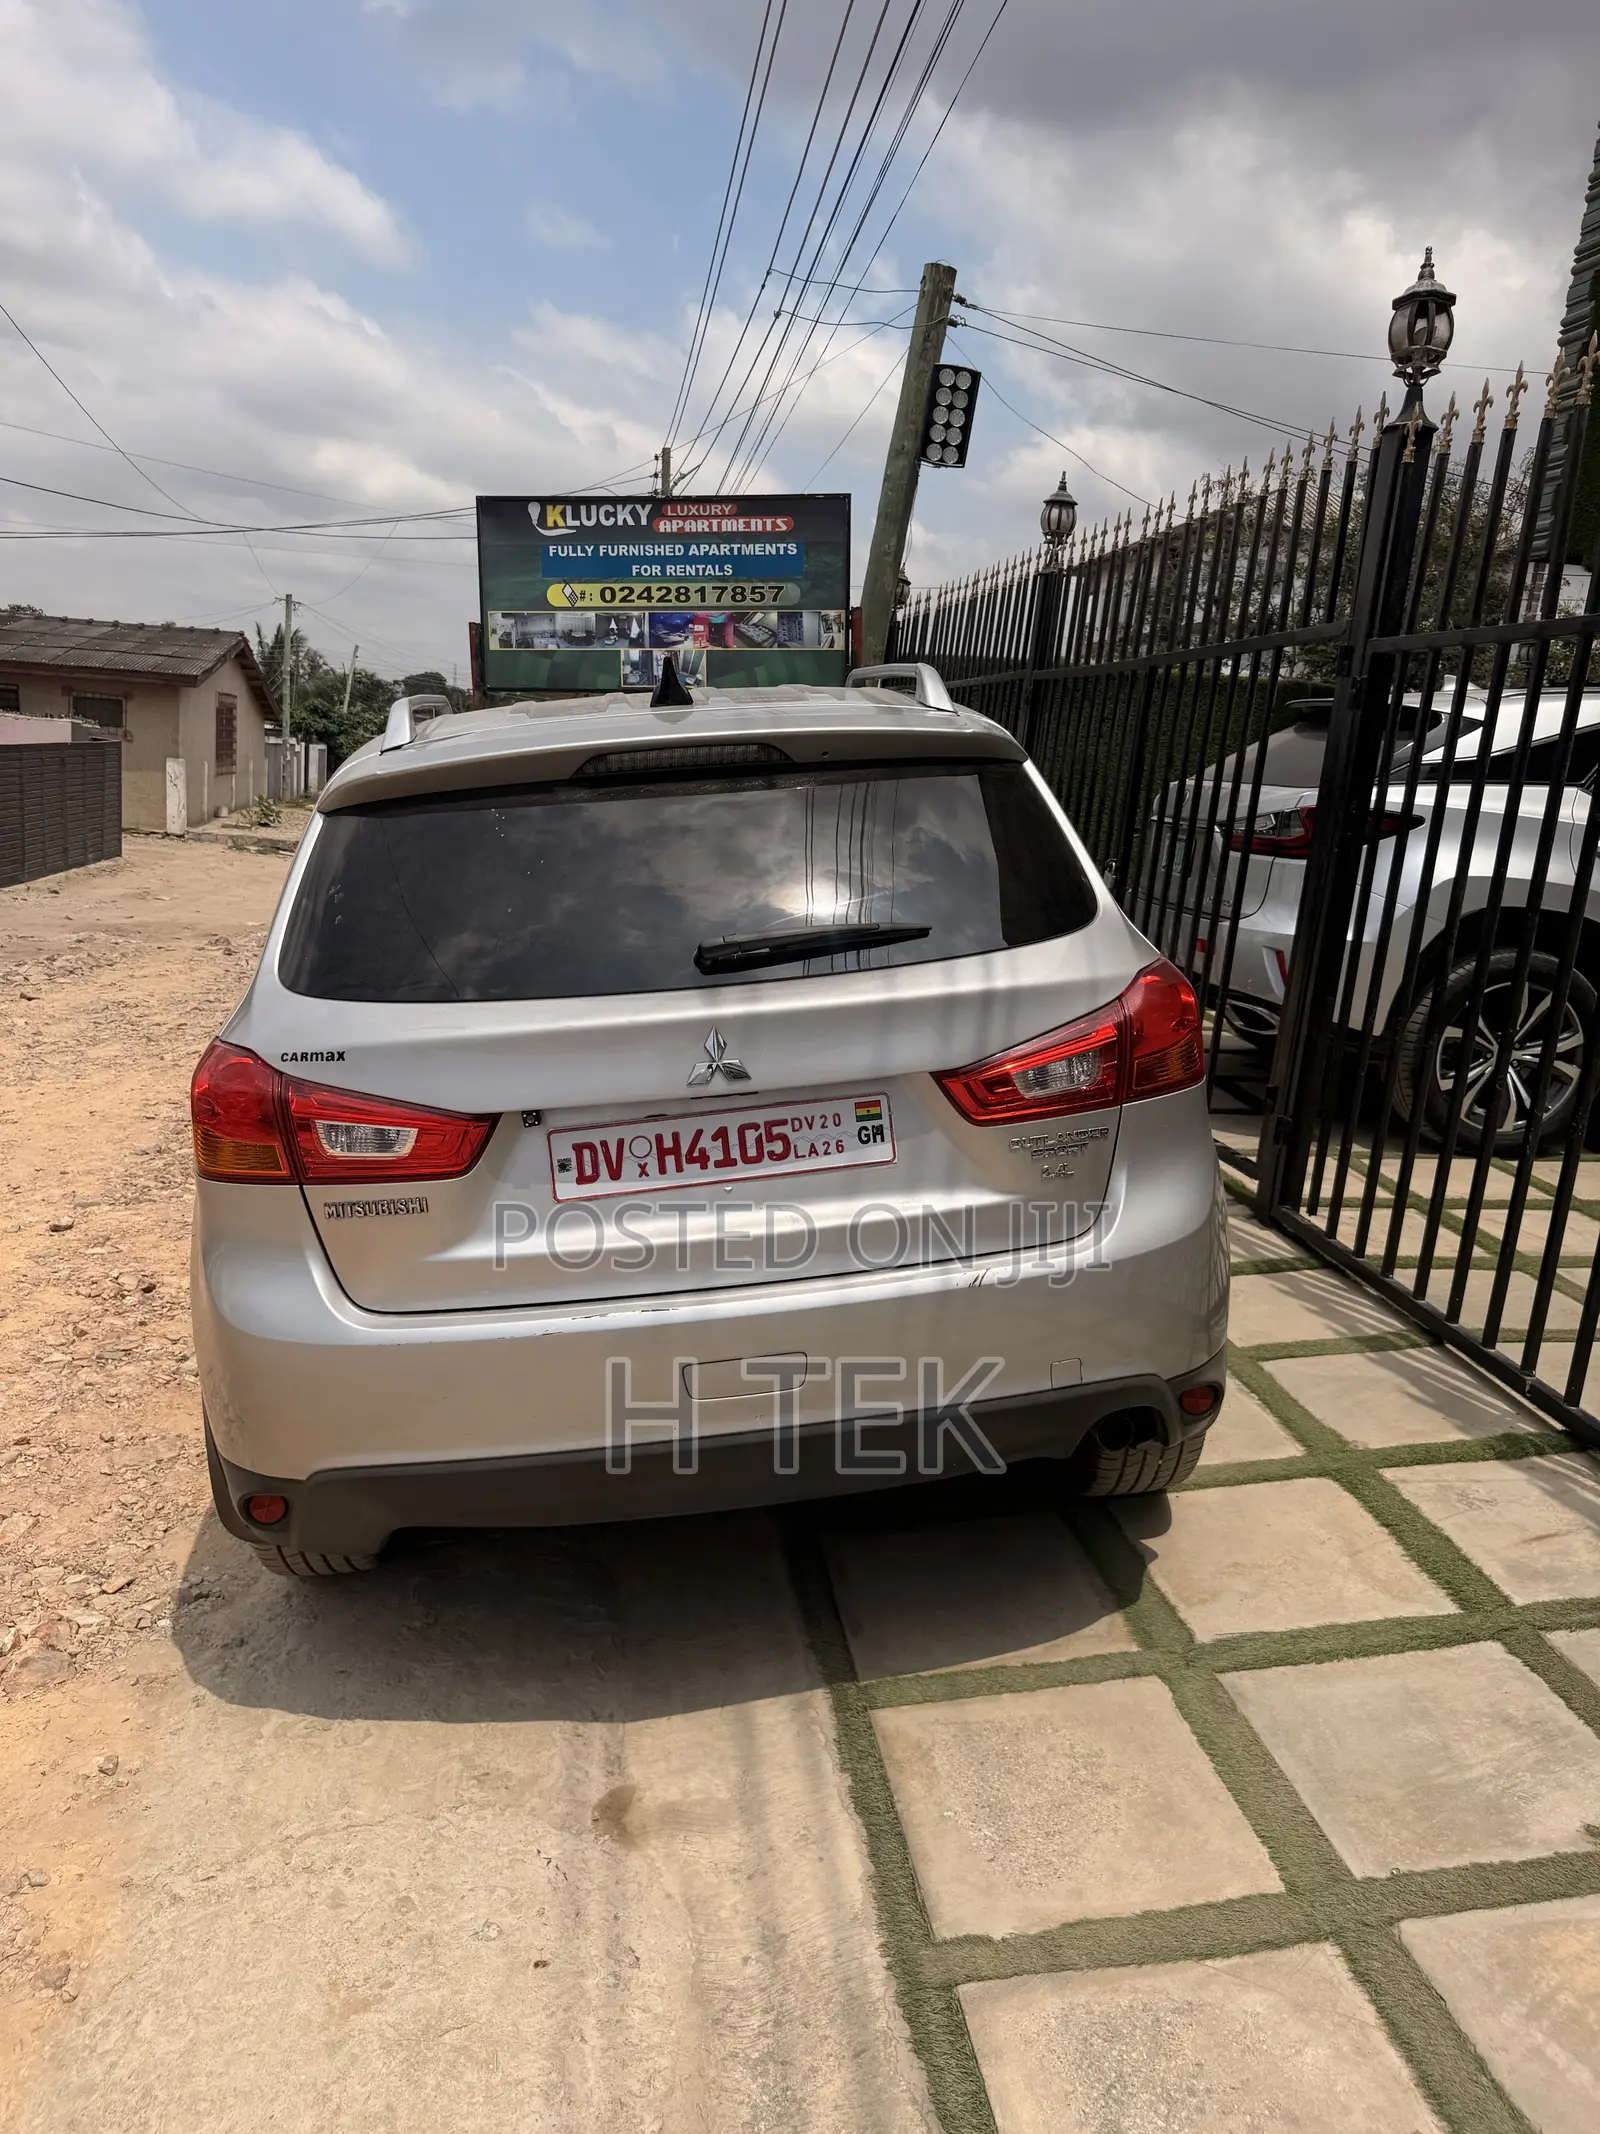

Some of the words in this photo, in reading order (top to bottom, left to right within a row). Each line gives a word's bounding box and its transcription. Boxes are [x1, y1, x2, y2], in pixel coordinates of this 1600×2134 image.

[546, 503, 652, 528] KLUCKY
[667, 504, 732, 516] LUXURY
[658, 518, 788, 532] APARTMENTS
[549, 545, 594, 557] FULLY
[599, 544, 684, 557] FURNISHED
[688, 543, 798, 556] APARTMENTS
[632, 565, 661, 577] FOR
[666, 564, 733, 577] RENTALS
[599, 585, 785, 604] 0242817857
[857, 1123, 886, 1146] GH
[1009, 1126, 1109, 1149] OUTLANDER
[571, 1137, 625, 1185] DV
[654, 1118, 791, 1174] H4105
[1031, 1142, 1090, 1160] SPORT
[323, 1197, 429, 1220] MITSUBISHI
